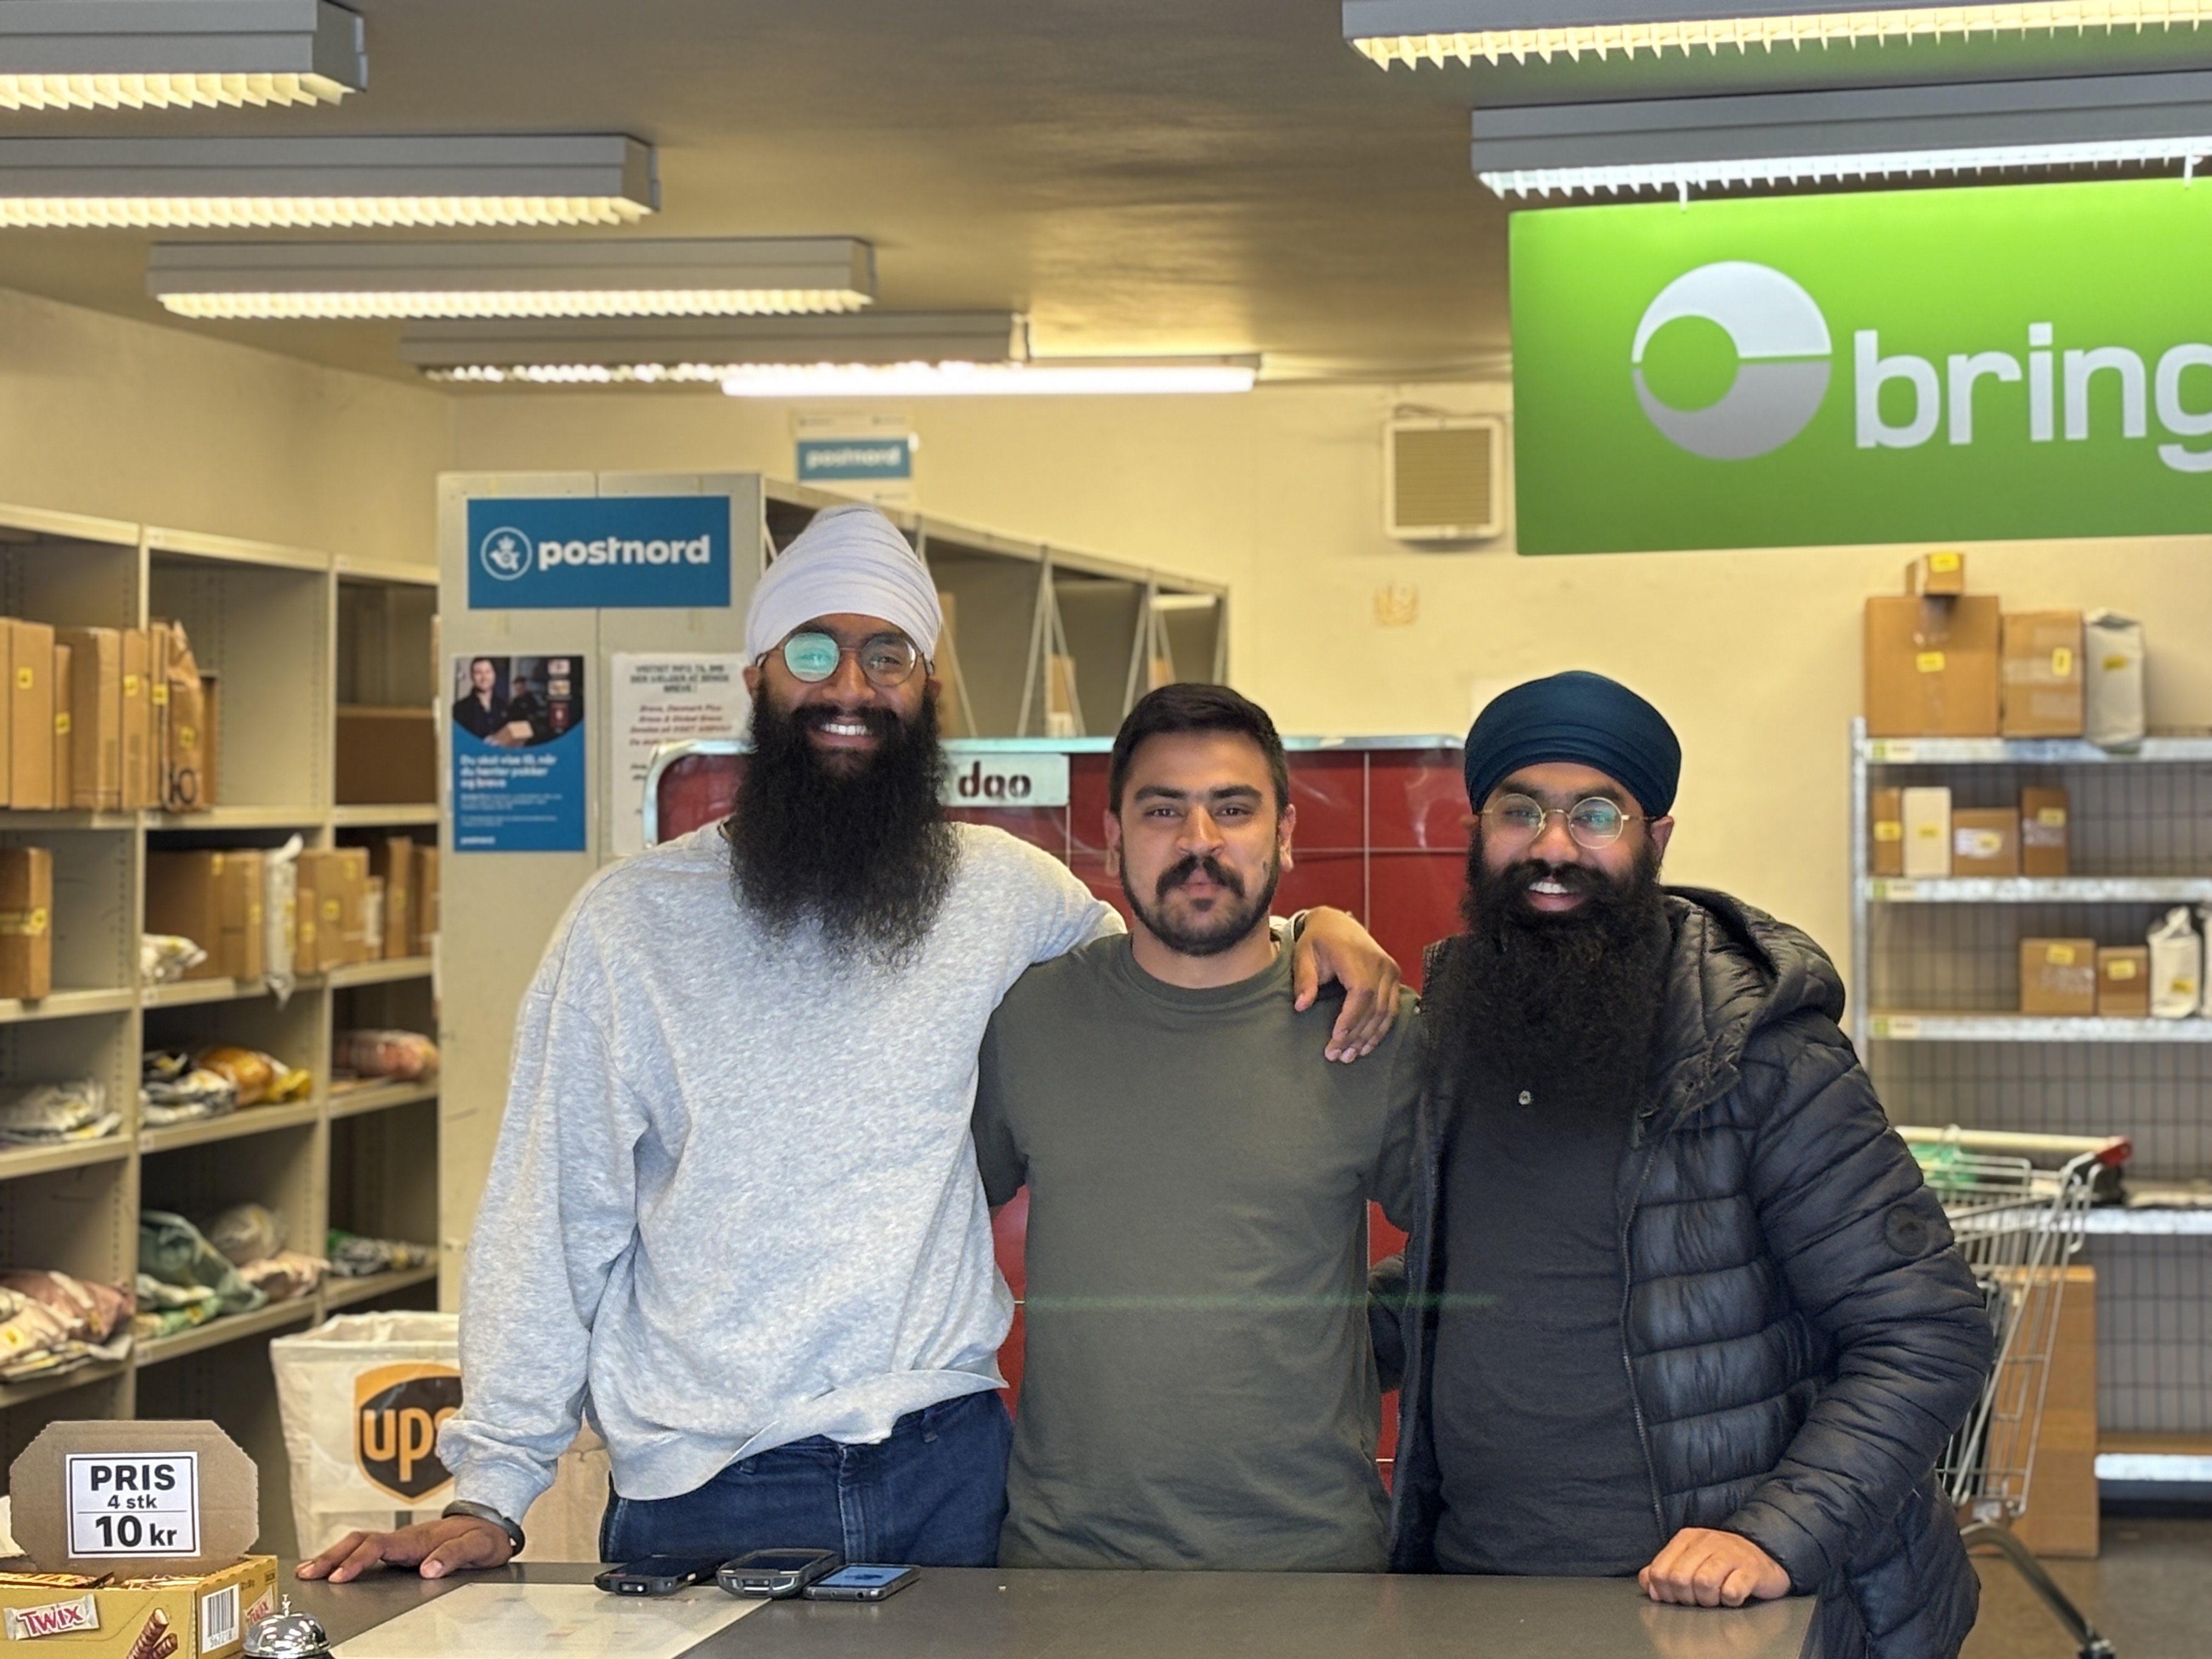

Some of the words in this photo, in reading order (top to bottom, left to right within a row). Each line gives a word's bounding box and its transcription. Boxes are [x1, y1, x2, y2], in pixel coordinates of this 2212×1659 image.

[1853, 321, 2212, 472] bring
[805, 445, 901, 471] postnord
[537, 534, 711, 571] postnord
[90, 1464, 176, 1492] PRIS
[107, 1494, 121, 1509] 4
[126, 1494, 158, 1509] stk
[95, 1515, 143, 1548] 10
[150, 1523, 178, 1547] kr
